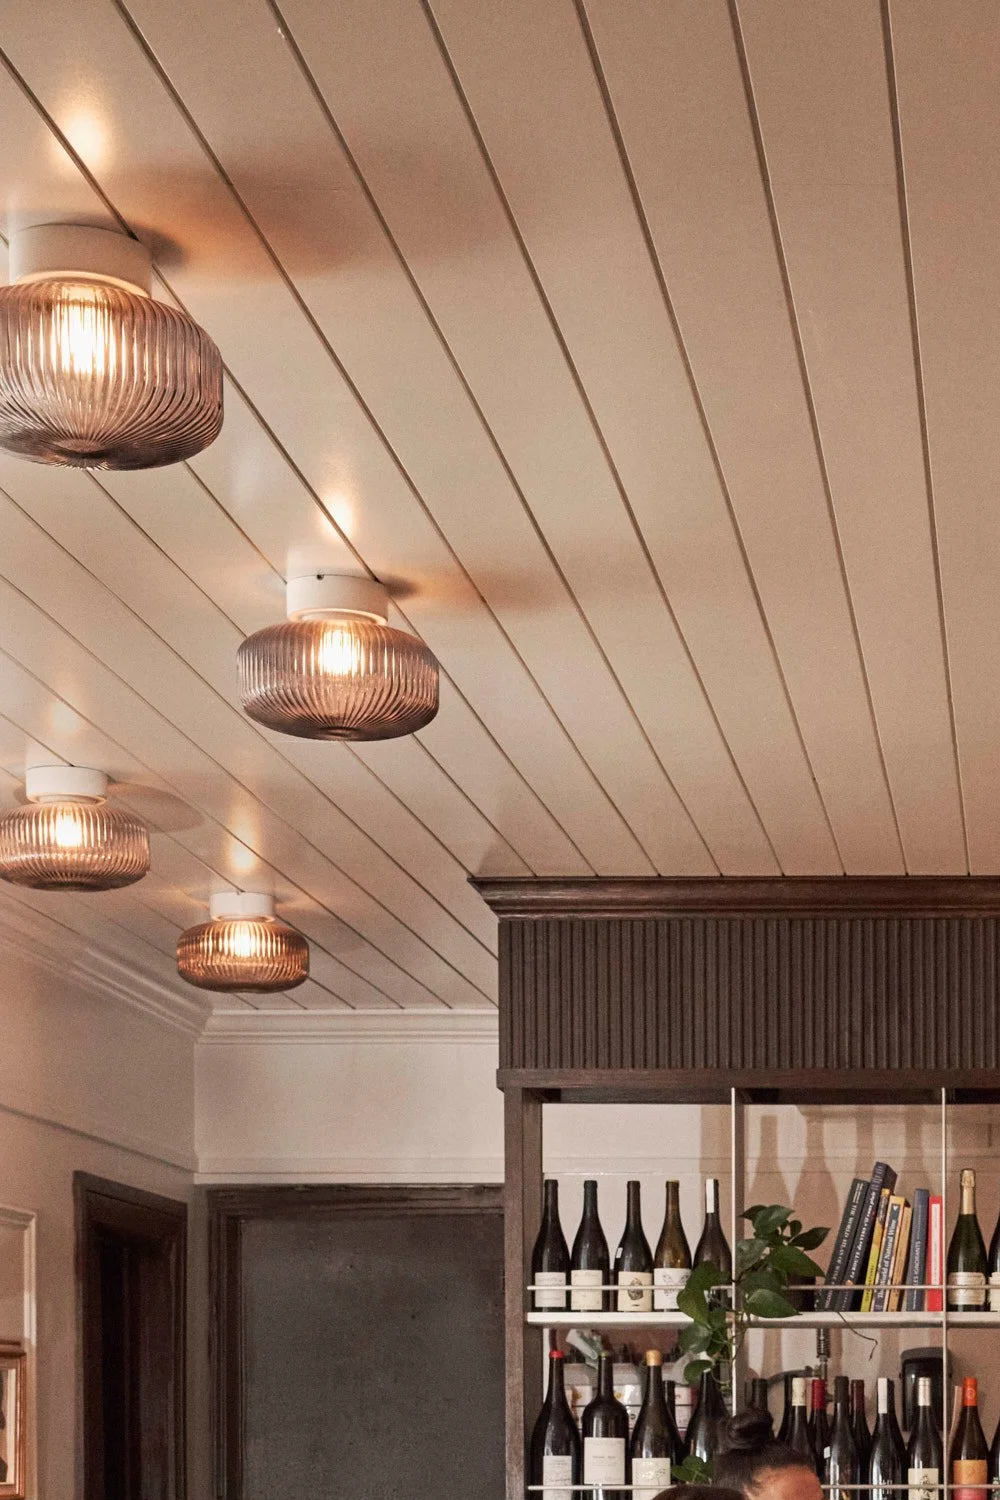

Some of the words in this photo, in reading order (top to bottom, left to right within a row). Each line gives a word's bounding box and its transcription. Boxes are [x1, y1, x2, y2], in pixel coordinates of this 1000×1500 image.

[845, 1216, 853, 1237] WORLD
[888, 1219, 896, 1235] Wine
[885, 1235, 893, 1259] Natural
